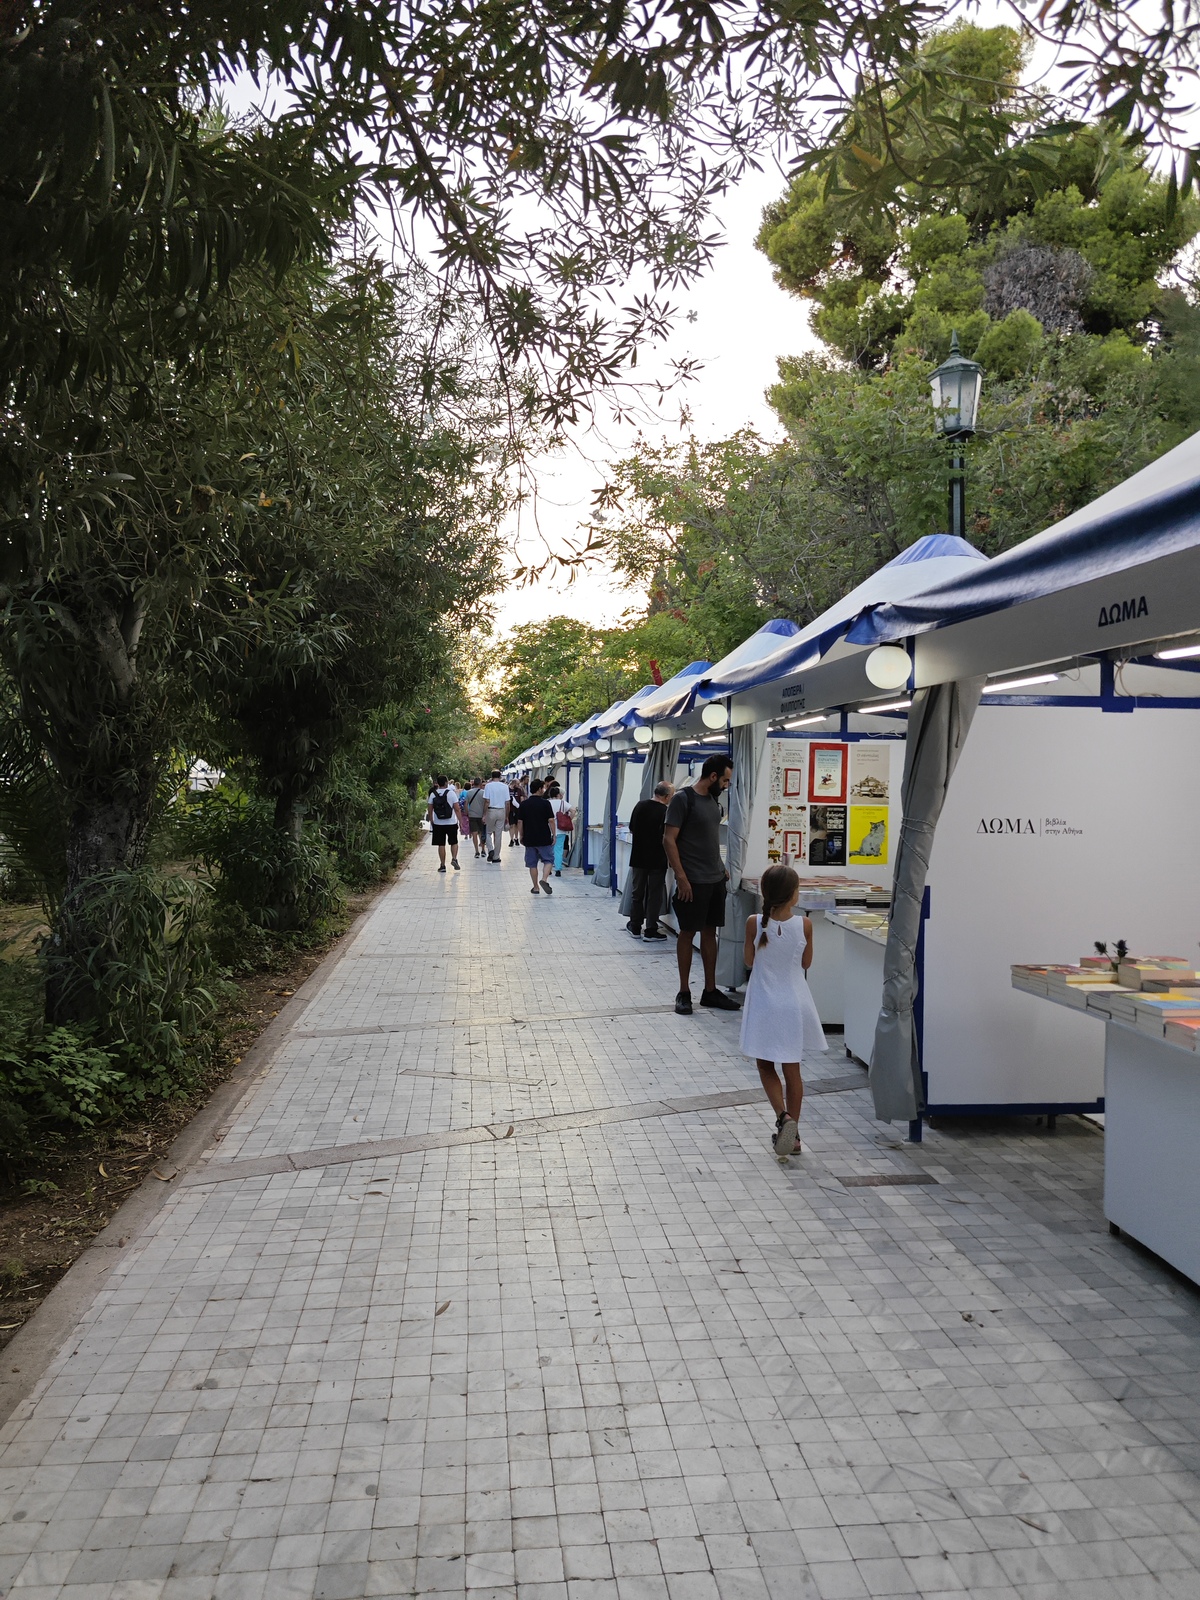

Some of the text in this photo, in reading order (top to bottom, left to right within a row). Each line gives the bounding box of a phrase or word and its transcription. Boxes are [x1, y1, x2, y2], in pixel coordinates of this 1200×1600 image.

[1098, 595, 1149, 627] ΔΩΜΑ
[976, 818, 1036, 834] ΔΩΜΑ
[1045, 818, 1067, 826] βιβλία
[1045, 827, 1083, 836] στην Αθήνα
